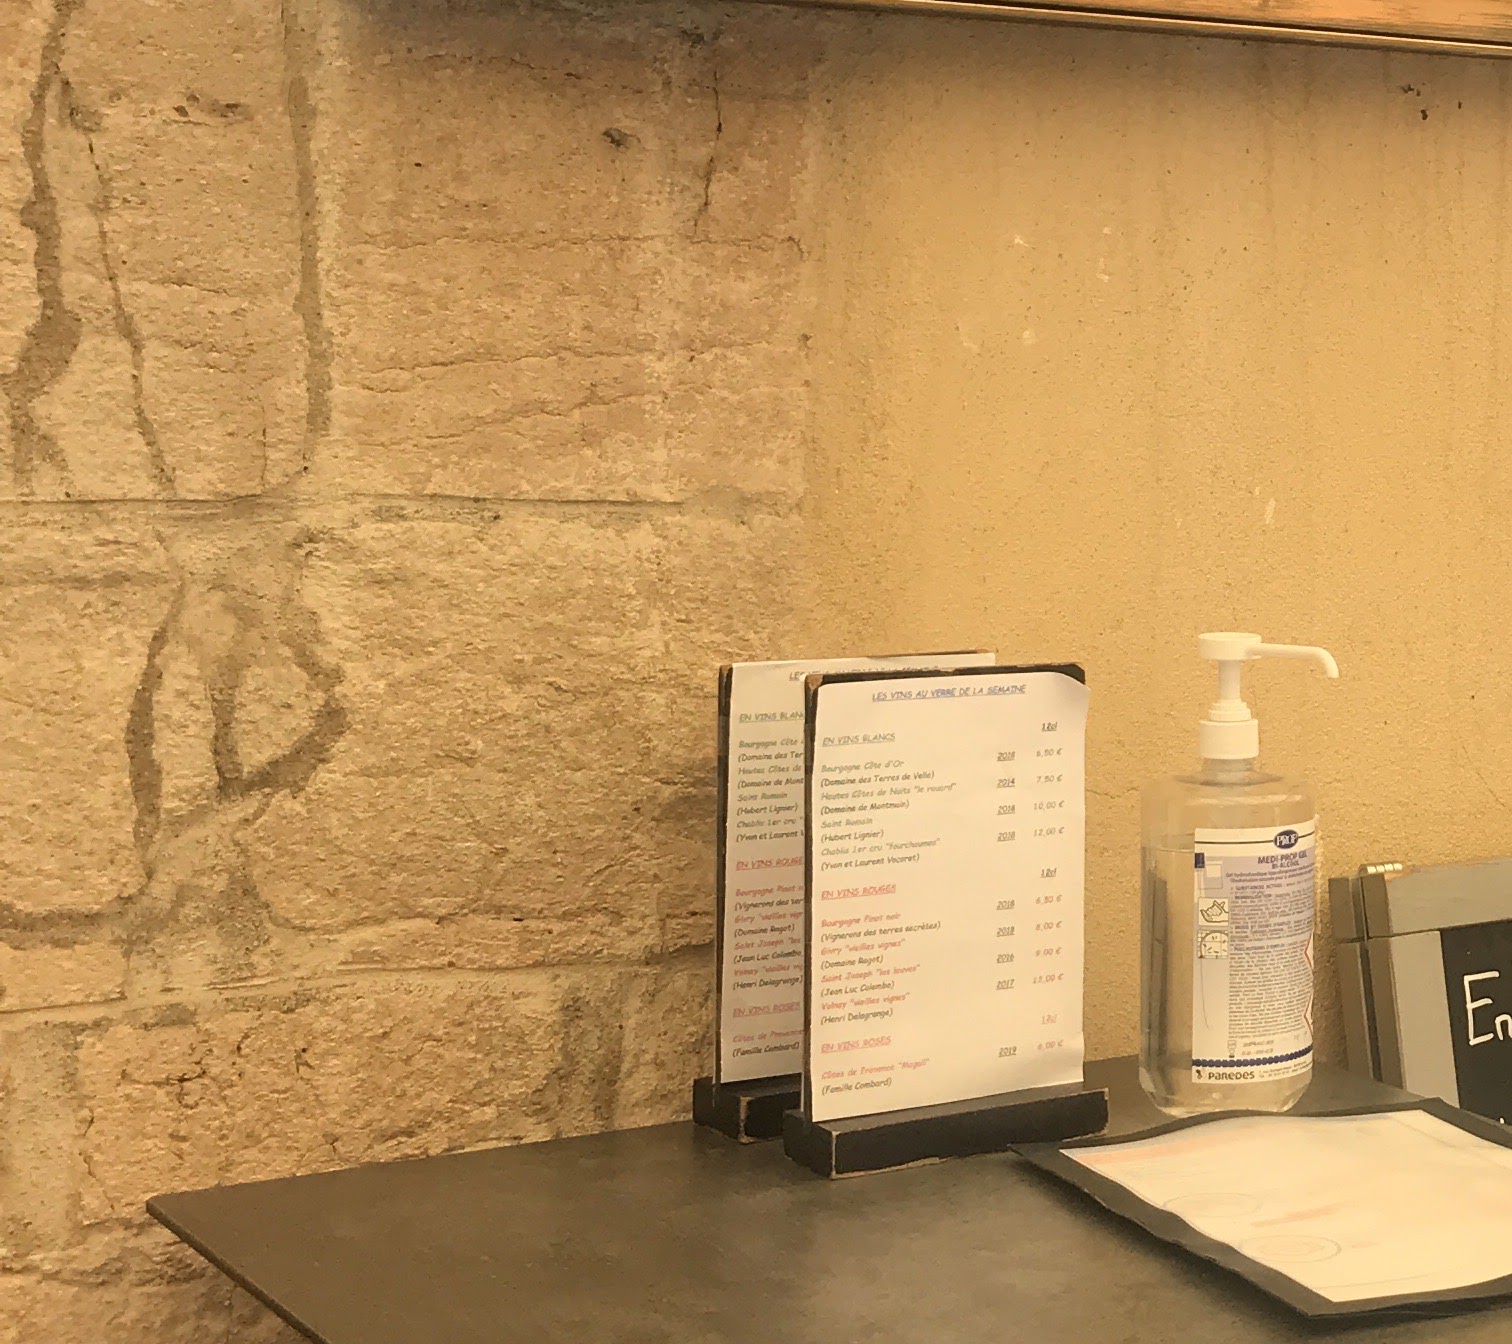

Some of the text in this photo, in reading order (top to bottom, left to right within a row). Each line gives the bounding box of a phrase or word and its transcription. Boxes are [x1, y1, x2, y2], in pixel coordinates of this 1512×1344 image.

[872, 692, 887, 701] LES
[890, 691, 912, 700] VINS
[916, 690, 928, 699] AU
[958, 687, 970, 697] DE
[972, 687, 984, 696] LA
[987, 684, 1026, 695] SEMAINE
[822, 733, 896, 745] EN VINS BLANCS
[820, 775, 856, 788] (Domaine
[858, 774, 872, 783] des
[874, 773, 900, 782] Terres
[902, 771, 911, 780] de
[821, 890, 834, 899] EN
[836, 888, 860, 898] VINS
[864, 927, 876, 936] des
[820, 986, 842, 998] (Jean
[844, 984, 858, 993] Luc
[820, 1012, 846, 1026] (Henri
